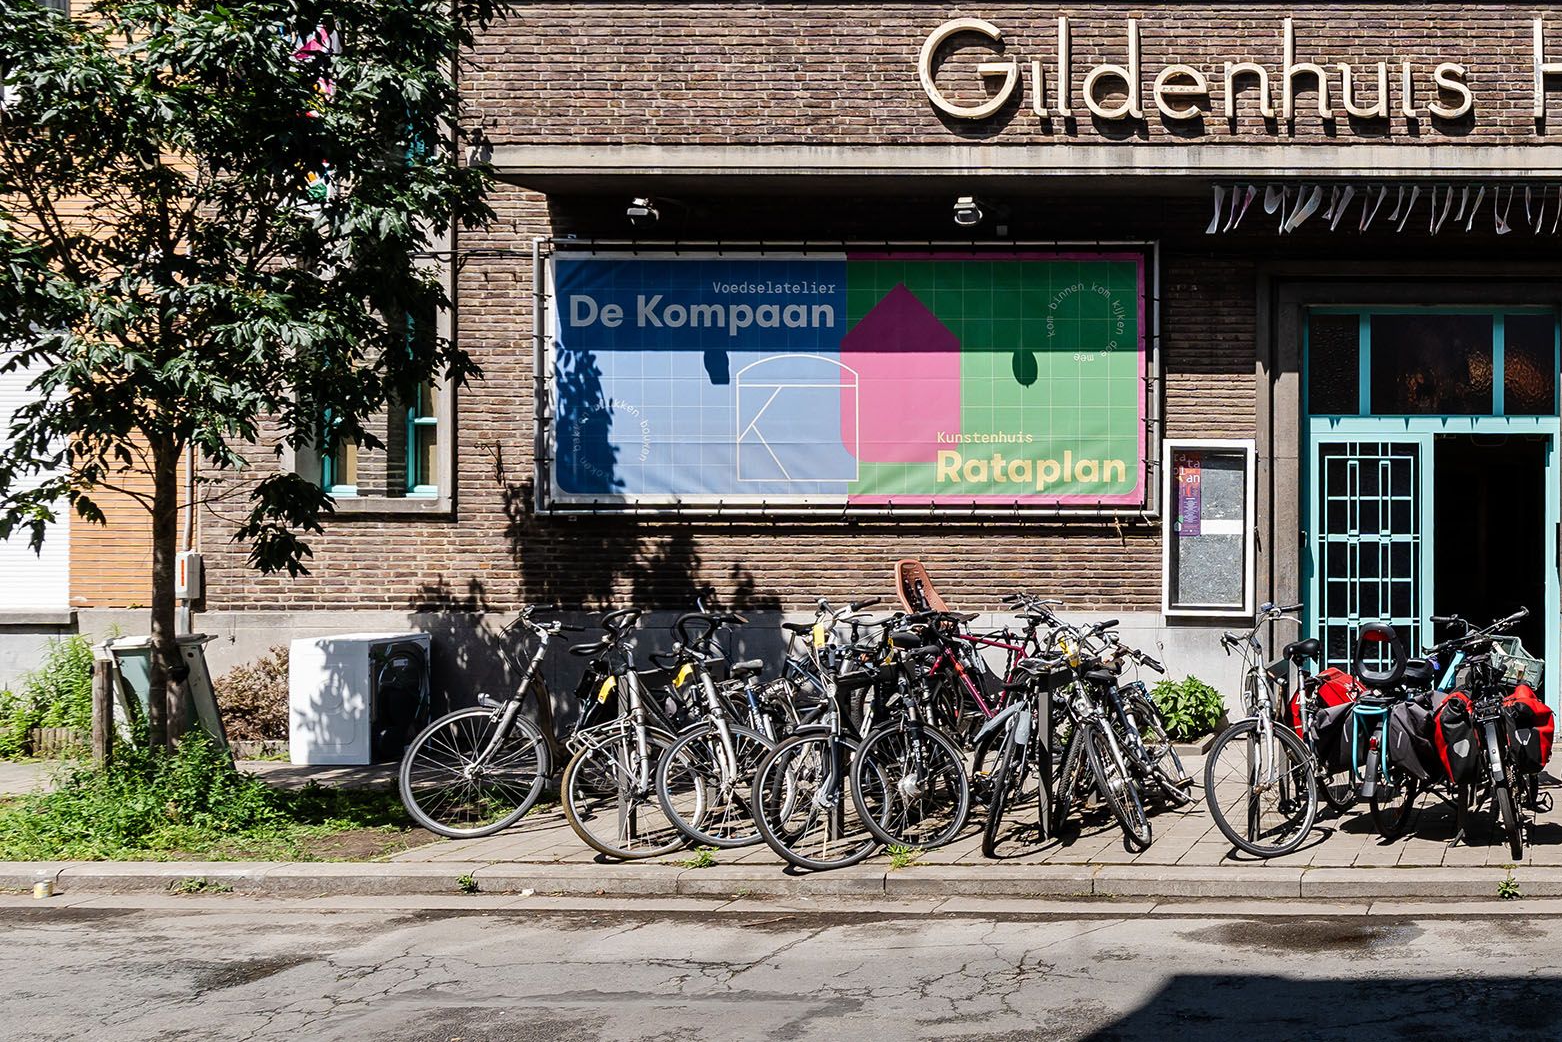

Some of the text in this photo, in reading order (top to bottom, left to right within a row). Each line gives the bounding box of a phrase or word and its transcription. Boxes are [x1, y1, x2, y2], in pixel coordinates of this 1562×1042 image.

[918, 16, 1474, 120] Gildenhuis
[712, 280, 837, 295] Voedselatelier
[1048, 282, 1085, 310] binnen
[1091, 282, 1111, 298] kom
[570, 294, 835, 336] De Kompaan
[1046, 315, 1055, 338] kom
[1112, 299, 1126, 335] kijken
[936, 430, 1034, 445] Kunstenhuis
[936, 450, 1127, 492] Rataplan
